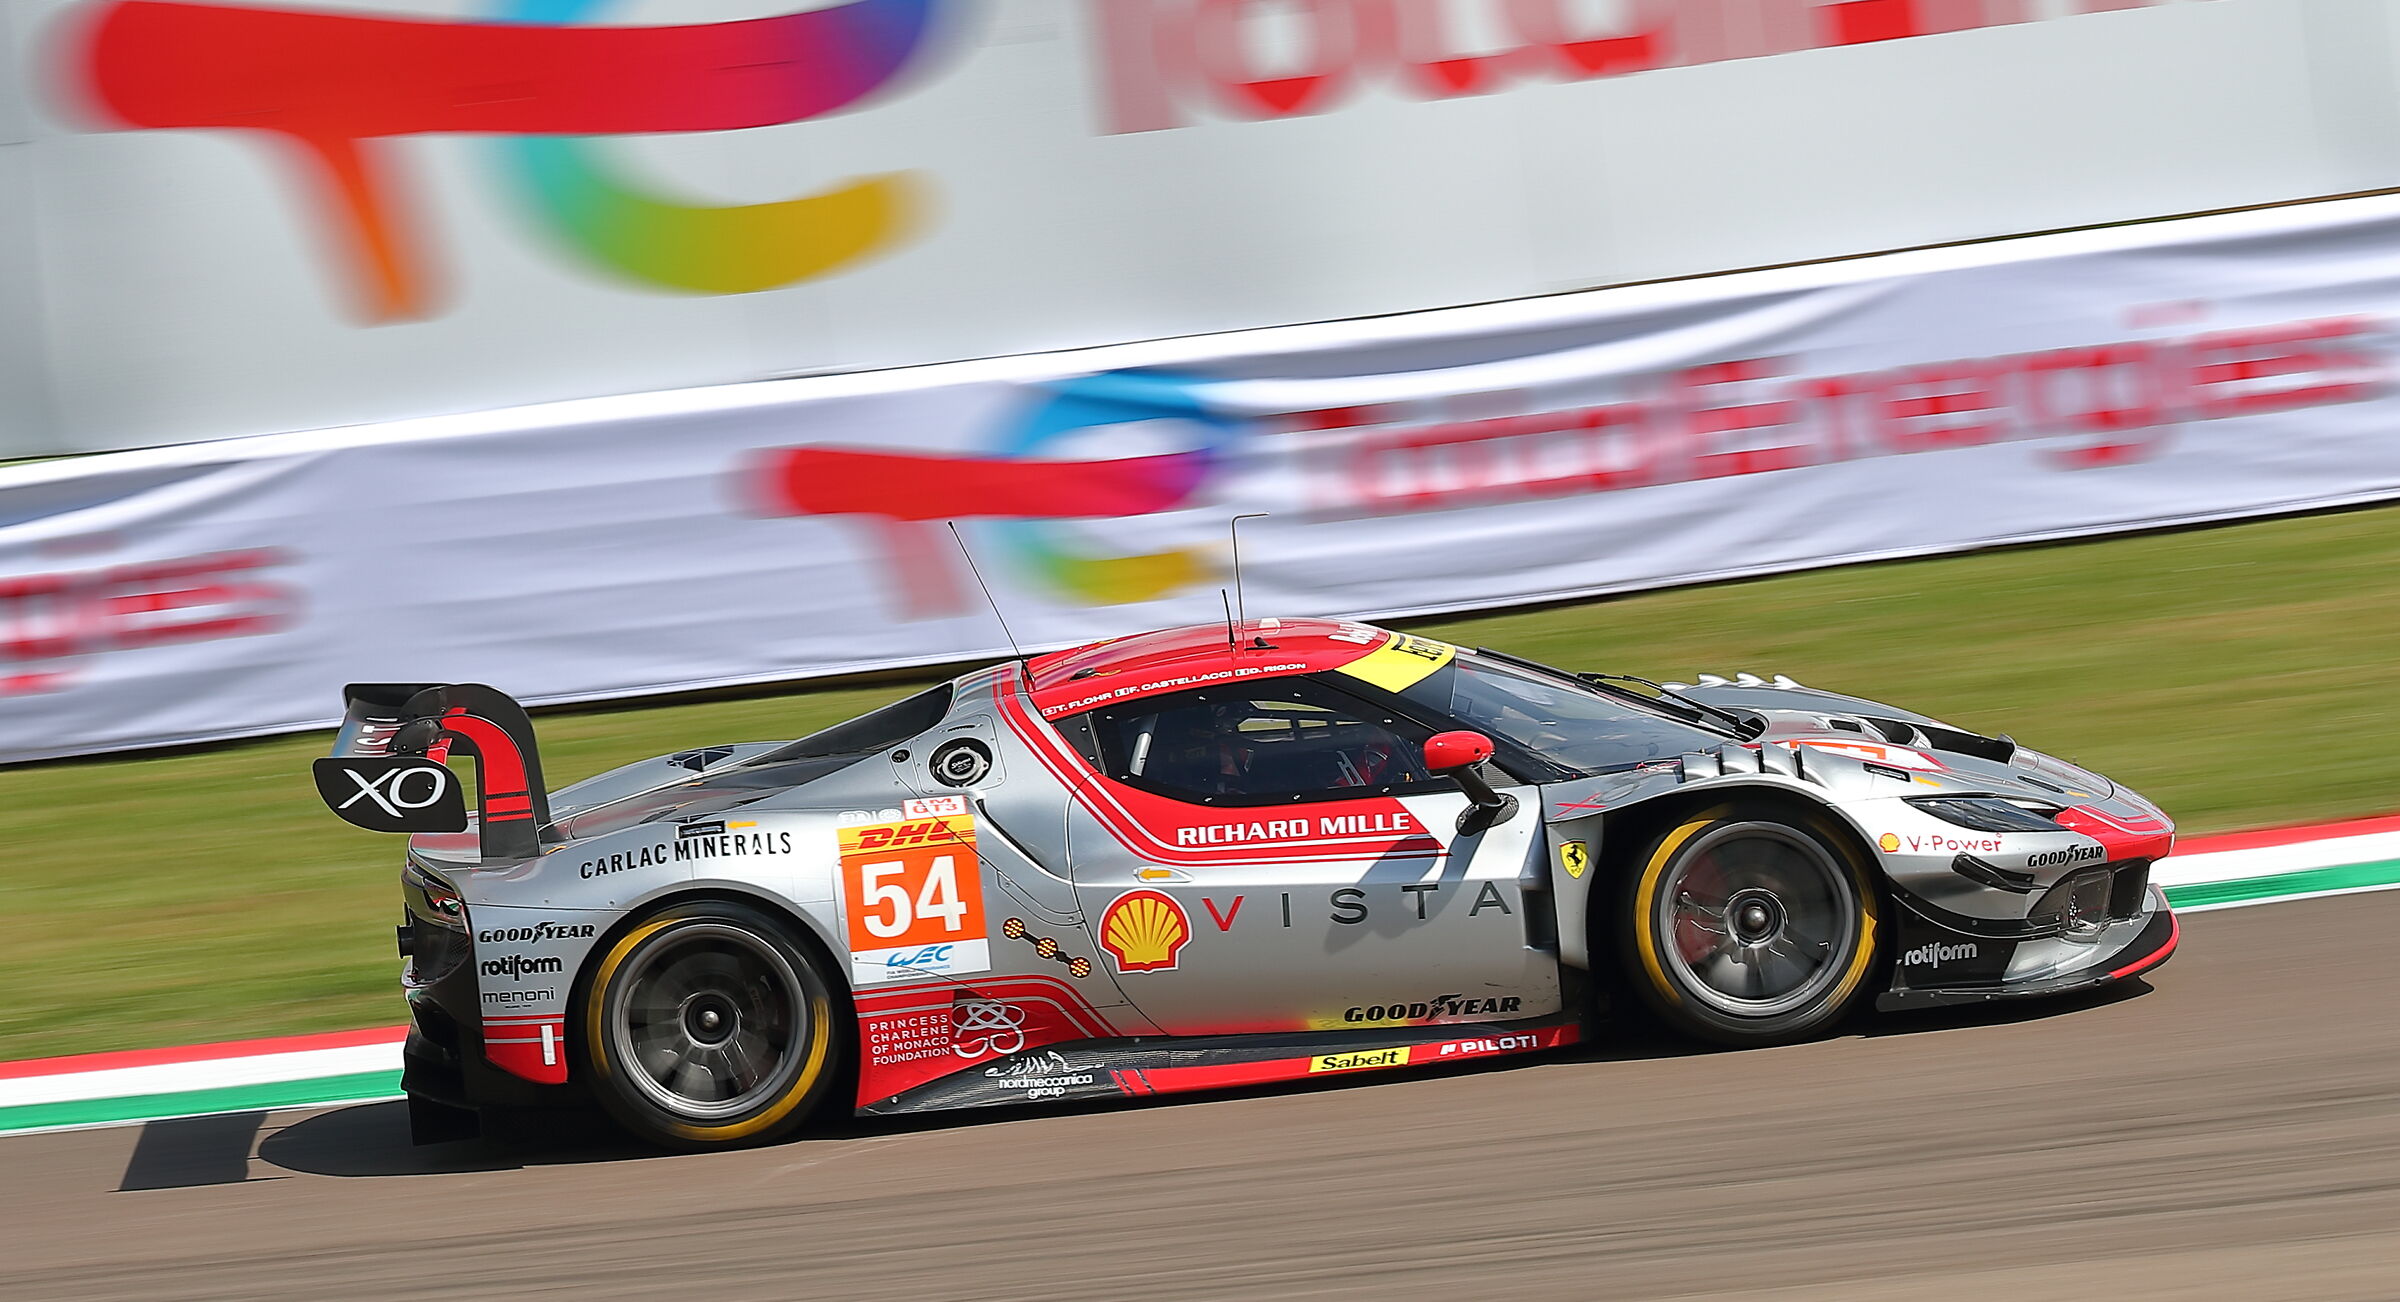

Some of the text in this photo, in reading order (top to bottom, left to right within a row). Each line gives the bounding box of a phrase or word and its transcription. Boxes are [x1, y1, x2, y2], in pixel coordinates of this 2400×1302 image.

[1249, 662, 1307, 676] D. RIGON
[1129, 670, 1233, 694] F. CASTELLACCI
[1057, 691, 1112, 713] T. FLOHR
[338, 767, 446, 818] XO
[913, 803, 958, 814] GT3
[858, 821, 957, 850] DHL
[1177, 811, 1411, 846] RICHARD MILLE
[1907, 833, 2001, 852] V-Power
[579, 831, 793, 880] CARLAC MINERALS
[2027, 843, 2104, 868] GOODYEAR
[861, 855, 968, 940] 54
[1201, 880, 1512, 931] VISTA
[479, 921, 596, 944] GOODYEAR
[886, 944, 954, 967] WEC
[1904, 942, 1978, 969] rotiform
[480, 954, 563, 982] rotiform
[482, 986, 556, 1004] menoni
[1343, 993, 1522, 1022] GOODYEAR
[869, 1014, 949, 1032] PRINCESS
[870, 1025, 950, 1043] CHARLENE
[872, 1036, 950, 1055] OF MONACO
[1462, 1034, 1538, 1054] PILOTI
[873, 1047, 951, 1066] FOUNDATION
[1320, 1049, 1400, 1070] Sabelt
[998, 1073, 1094, 1089] nordmeccanica
[1027, 1086, 1066, 1100] group
